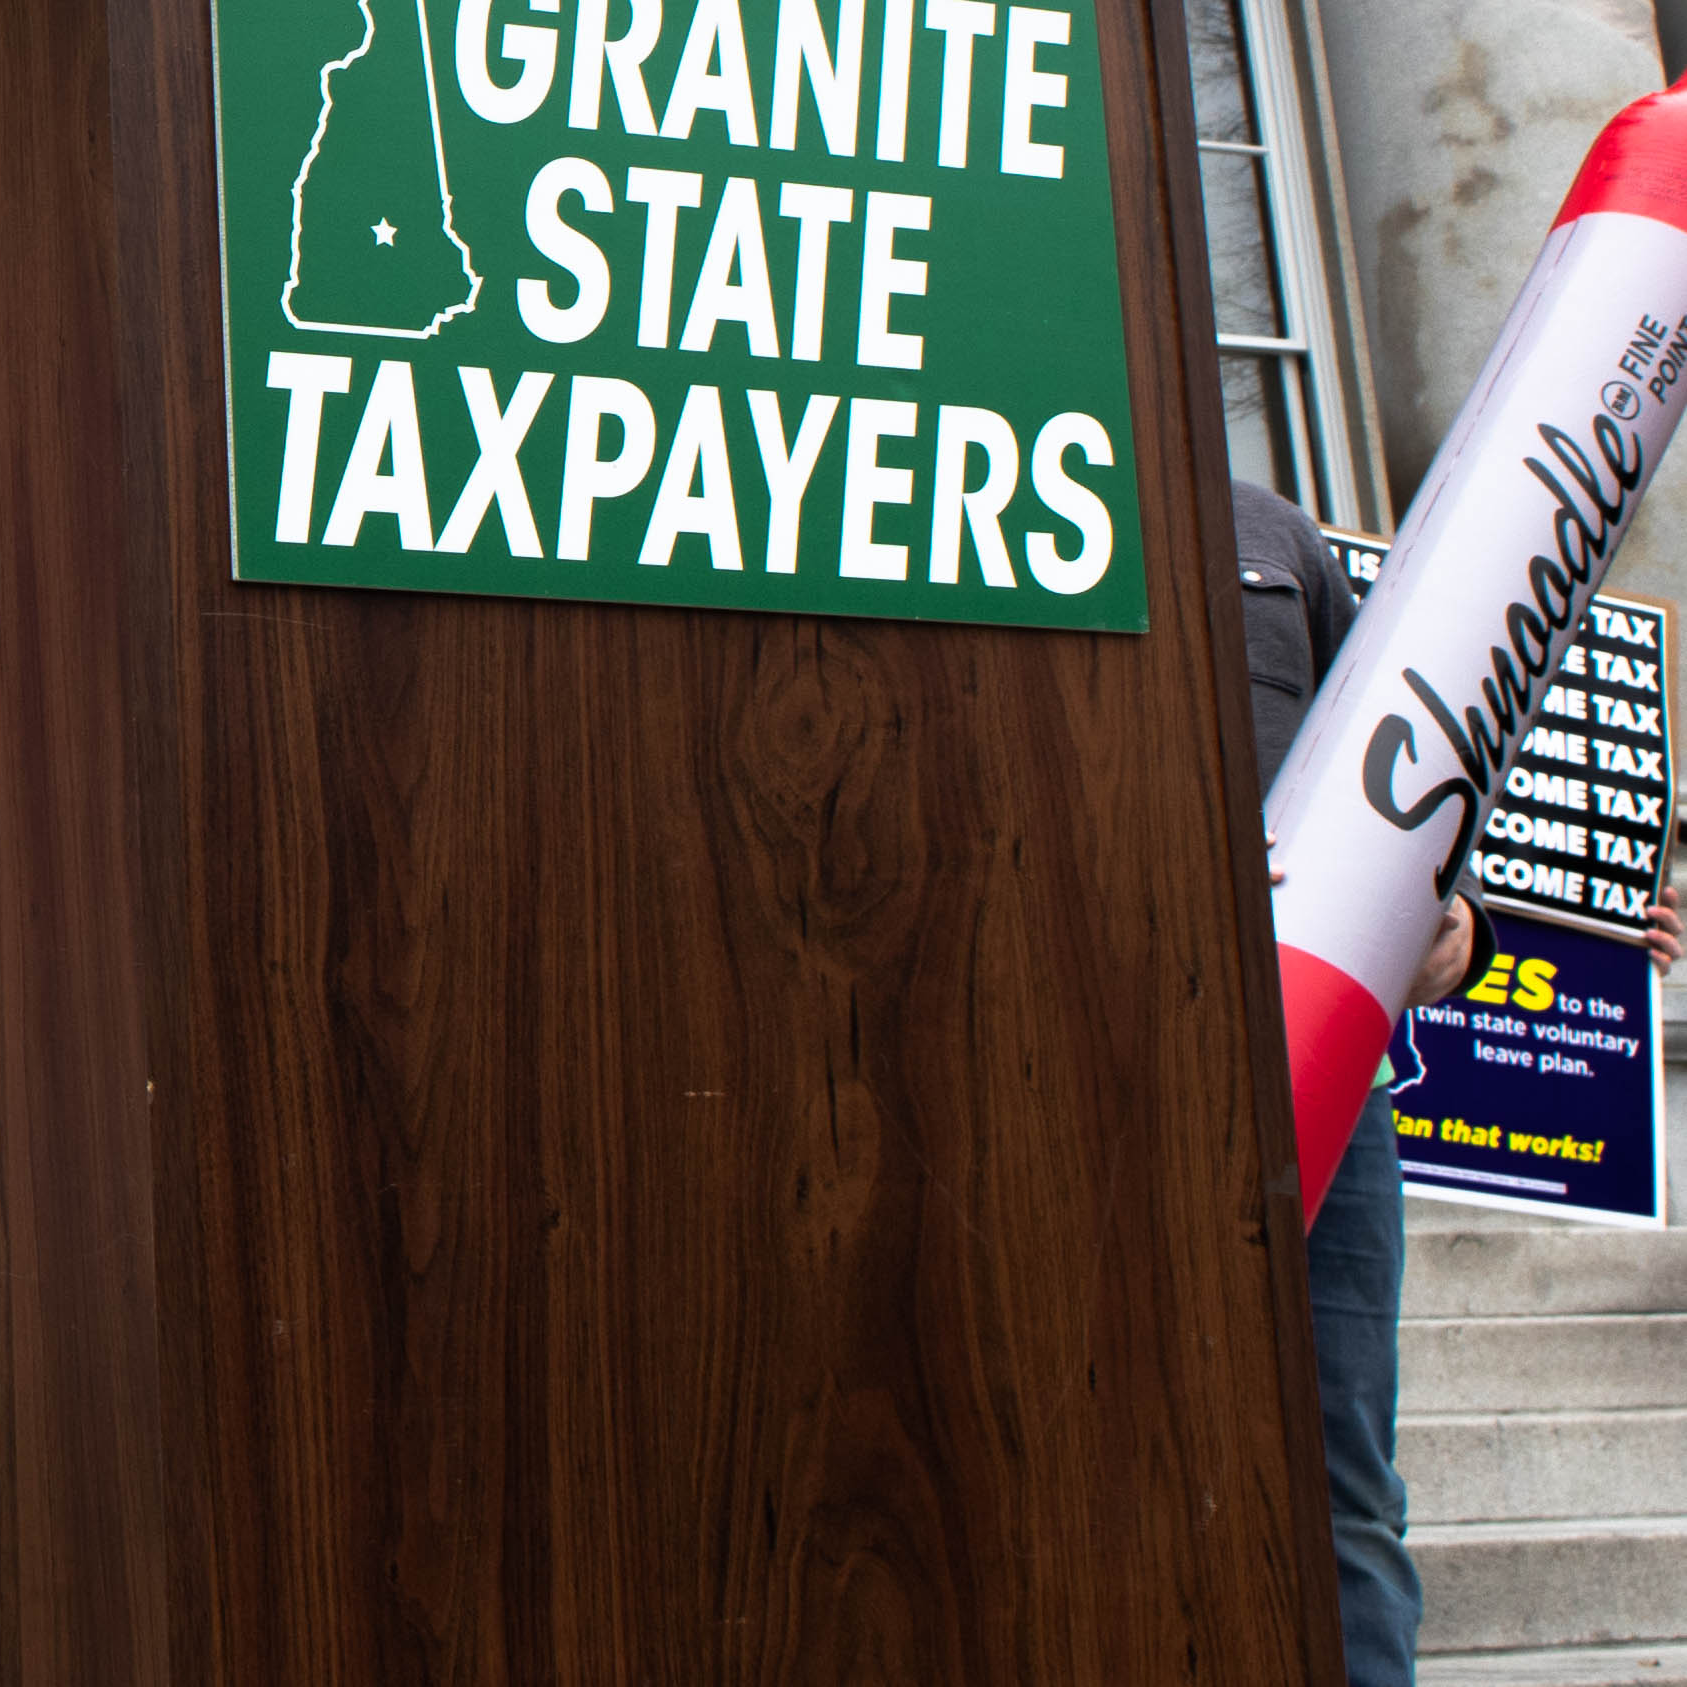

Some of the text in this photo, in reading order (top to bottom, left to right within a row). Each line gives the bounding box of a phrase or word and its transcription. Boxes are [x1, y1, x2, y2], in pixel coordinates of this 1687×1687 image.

[516, 156, 933, 370] STATE
[1617, 313, 1669, 381] FINE
[266, 350, 1116, 596] TAXPAYERS
[1588, 604, 1658, 649] TAX
[1362, 414, 1643, 904] Shnoodle
[1589, 648, 1660, 693] TAX
[1590, 692, 1662, 737] TAX
[1591, 737, 1664, 782] TAX
[1591, 783, 1663, 828] TAX
[1591, 829, 1658, 874] TAX
[1588, 876, 1651, 921] TAX
[1557, 992, 1583, 1014] to
[1587, 997, 1626, 1022] the
[1416, 1004, 1640, 1058] twin state voluntary
[1473, 1038, 1596, 1078] leave plan.
[1440, 1118, 1502, 1149] that
[1508, 1131, 1606, 1164] works!
